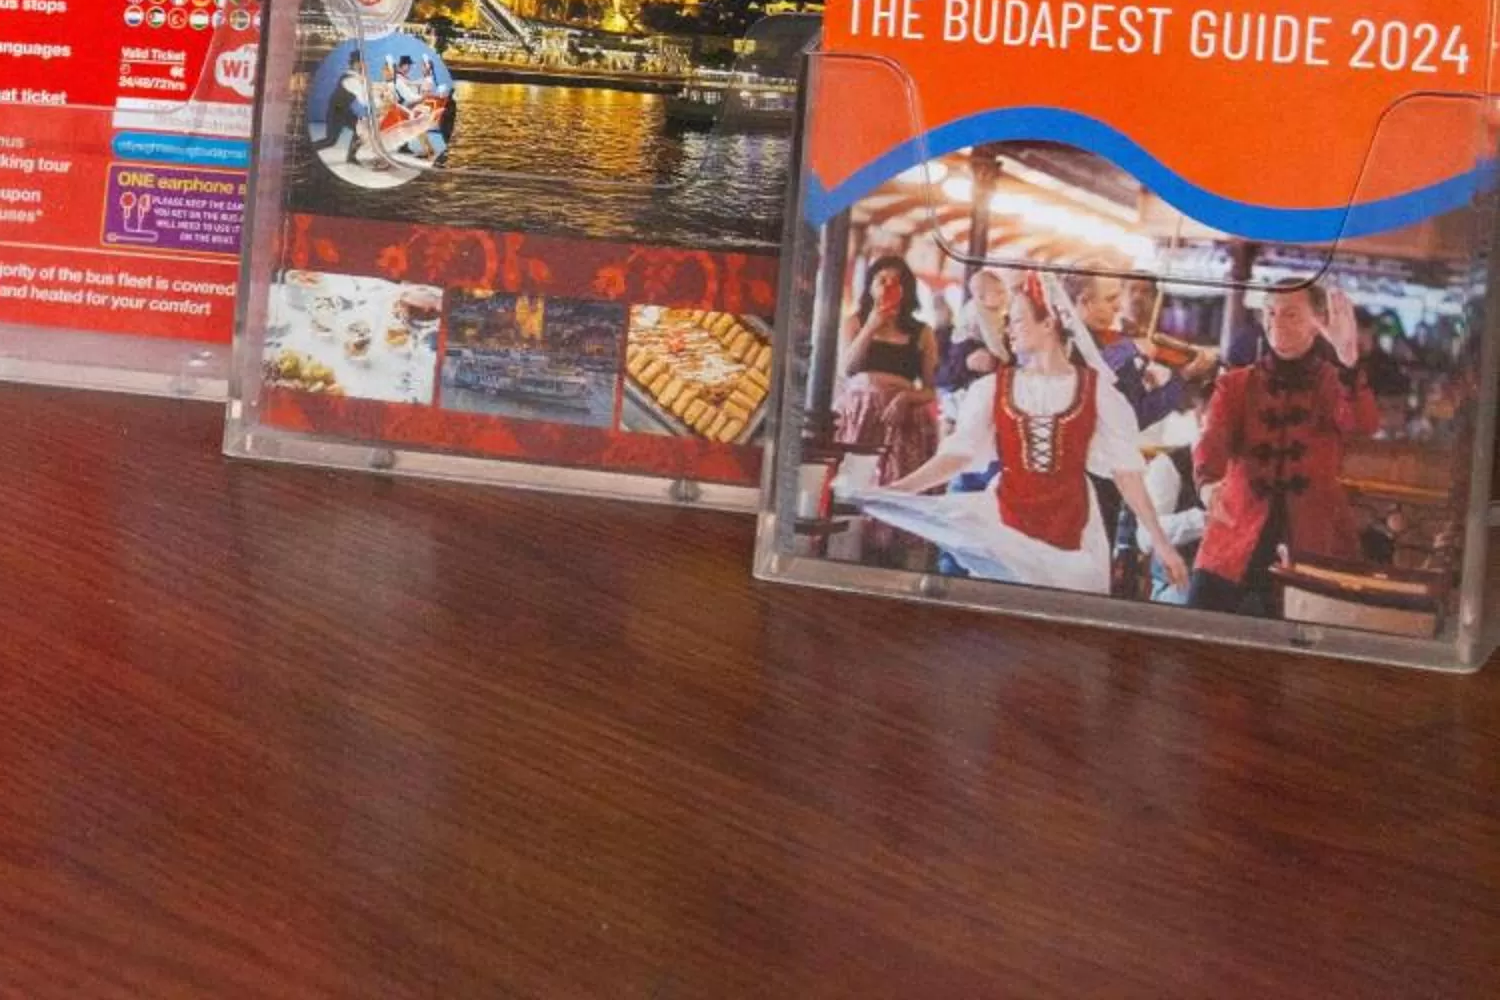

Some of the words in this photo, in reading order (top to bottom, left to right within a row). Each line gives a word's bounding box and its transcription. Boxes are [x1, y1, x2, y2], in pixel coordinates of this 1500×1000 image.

[1190, 9, 1333, 66] GUIDE
[1349, 18, 1470, 75] 2024
[21, 87, 68, 104] ticket
[38, 156, 72, 173] tour
[117, 171, 156, 188] ONE
[157, 176, 235, 195] earphone
[39, 264, 56, 279] of
[57, 265, 83, 283] the
[86, 267, 116, 285] bus
[118, 270, 153, 290] fleet
[155, 274, 169, 291] is
[171, 278, 237, 297] covered
[31, 284, 84, 305] heated
[86, 289, 109, 306] for
[111, 293, 147, 312] your
[149, 296, 212, 316] comfort
